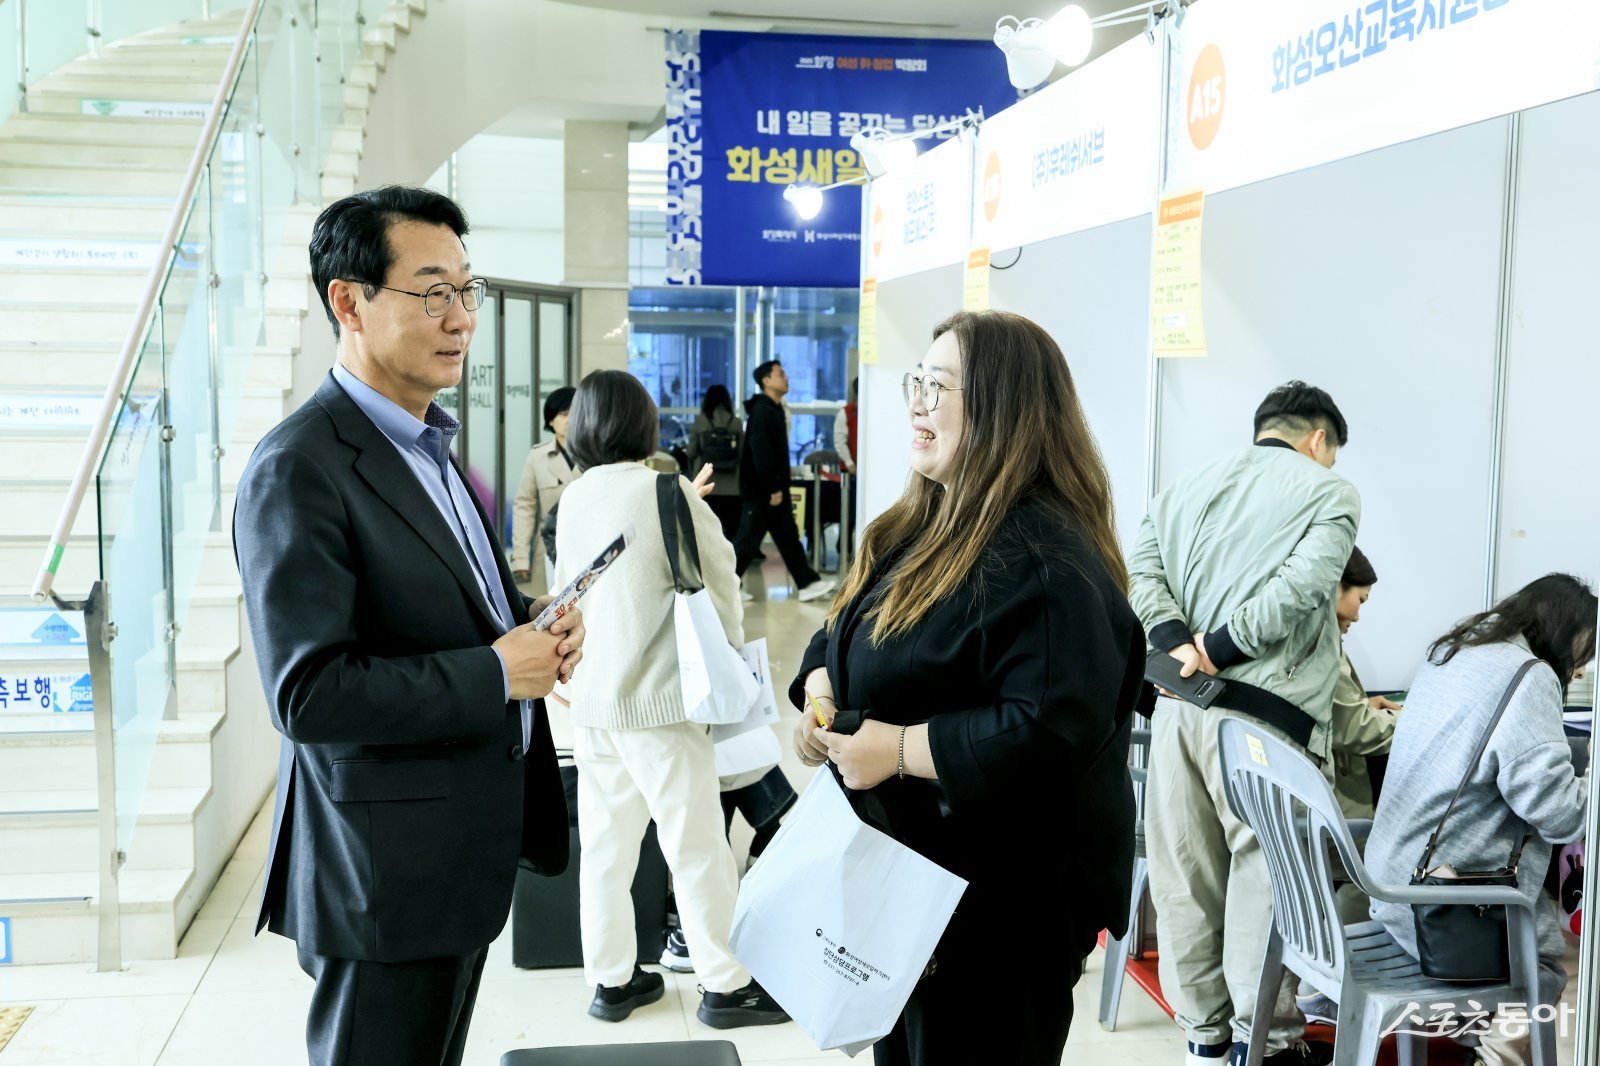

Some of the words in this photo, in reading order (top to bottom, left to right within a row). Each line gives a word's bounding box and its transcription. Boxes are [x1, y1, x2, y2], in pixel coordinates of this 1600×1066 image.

[1189, 74, 1222, 123] A15
[757, 110, 780, 135] 내
[787, 111, 832, 136] 일을
[470, 365, 494, 386] ART
[470, 392, 492, 408] HALL
[823, 947, 871, 982] 집단상담프로그램
